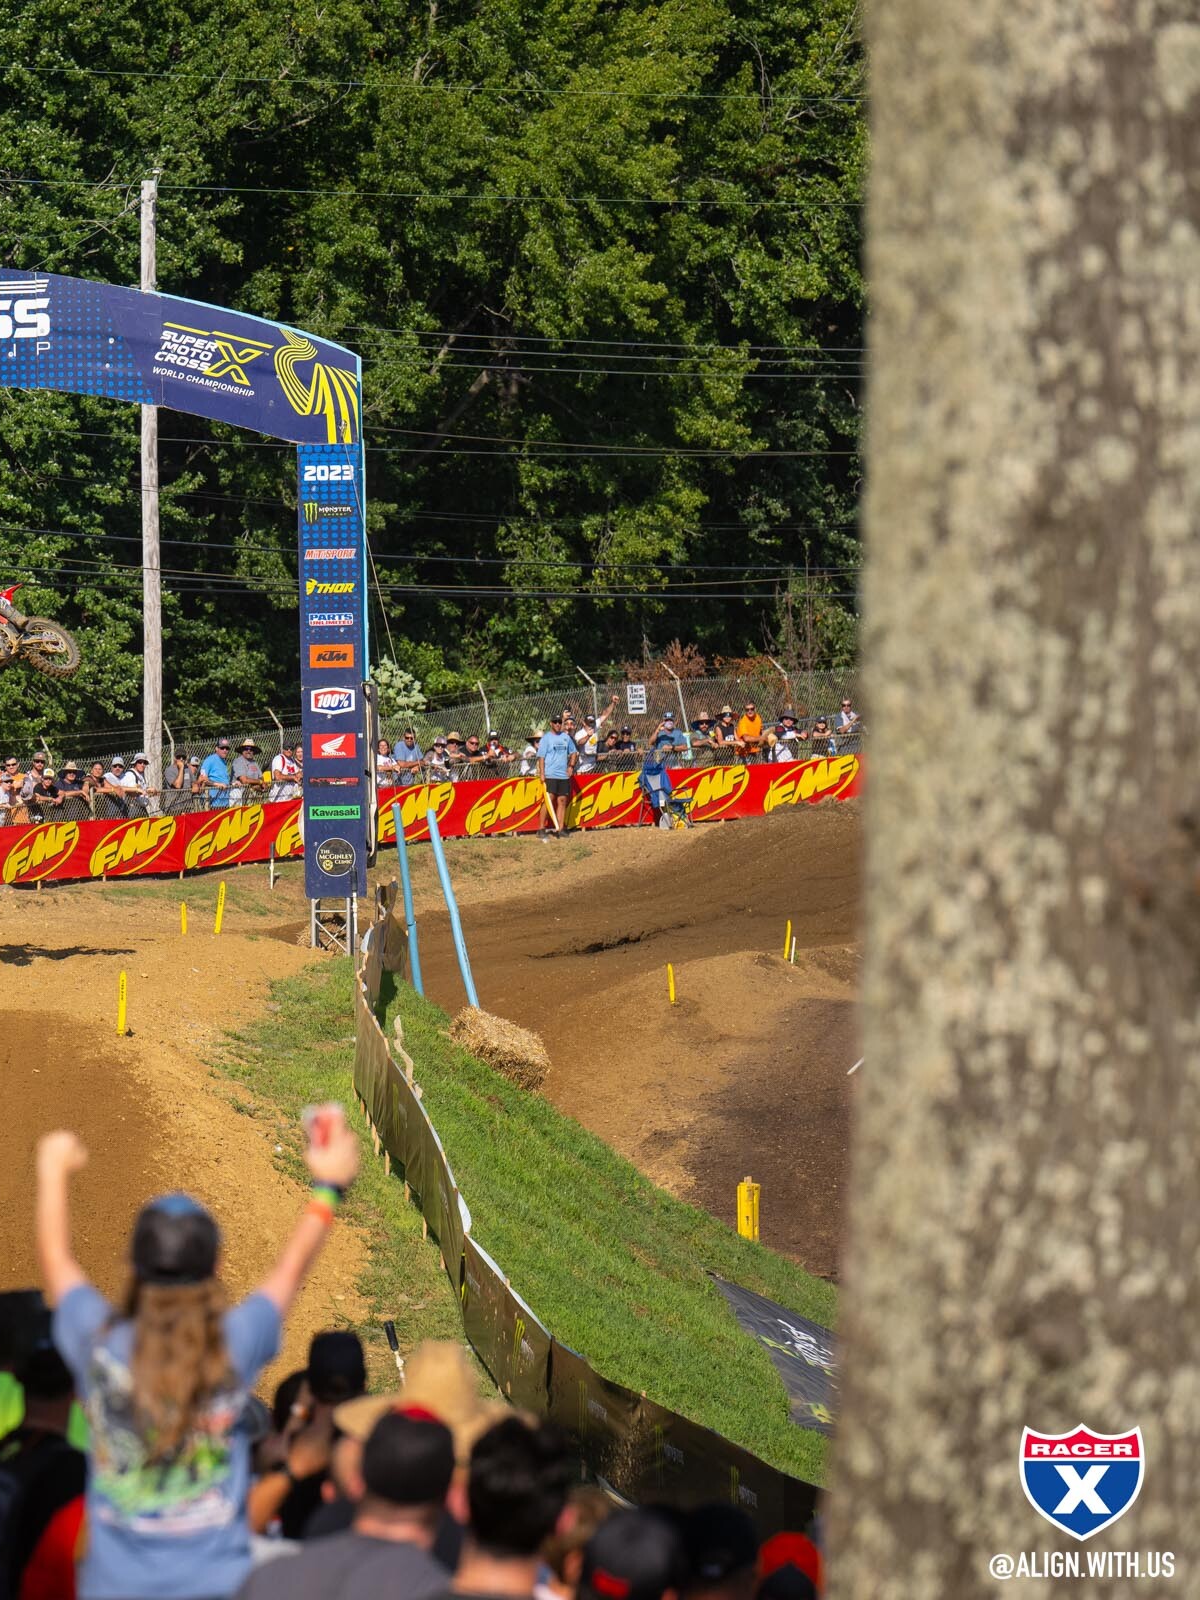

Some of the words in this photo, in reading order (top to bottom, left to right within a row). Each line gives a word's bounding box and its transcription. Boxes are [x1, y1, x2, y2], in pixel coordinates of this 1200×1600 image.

[160, 330, 218, 352] SUPER
[161, 341, 213, 362] MOTO
[154, 351, 212, 371] CROSS
[153, 366, 185, 380] WORLD
[186, 374, 255, 398] CHAMPIONSHIP
[304, 465, 354, 482] 2023
[317, 583, 355, 594] THOR
[316, 650, 348, 662] KTM
[317, 693, 350, 708] 100%
[767, 754, 855, 813] FMF
[312, 808, 359, 817] Kawasaki
[92, 816, 174, 877] FMF
[186, 804, 263, 869] FMF
[5, 821, 77, 884] FMF
